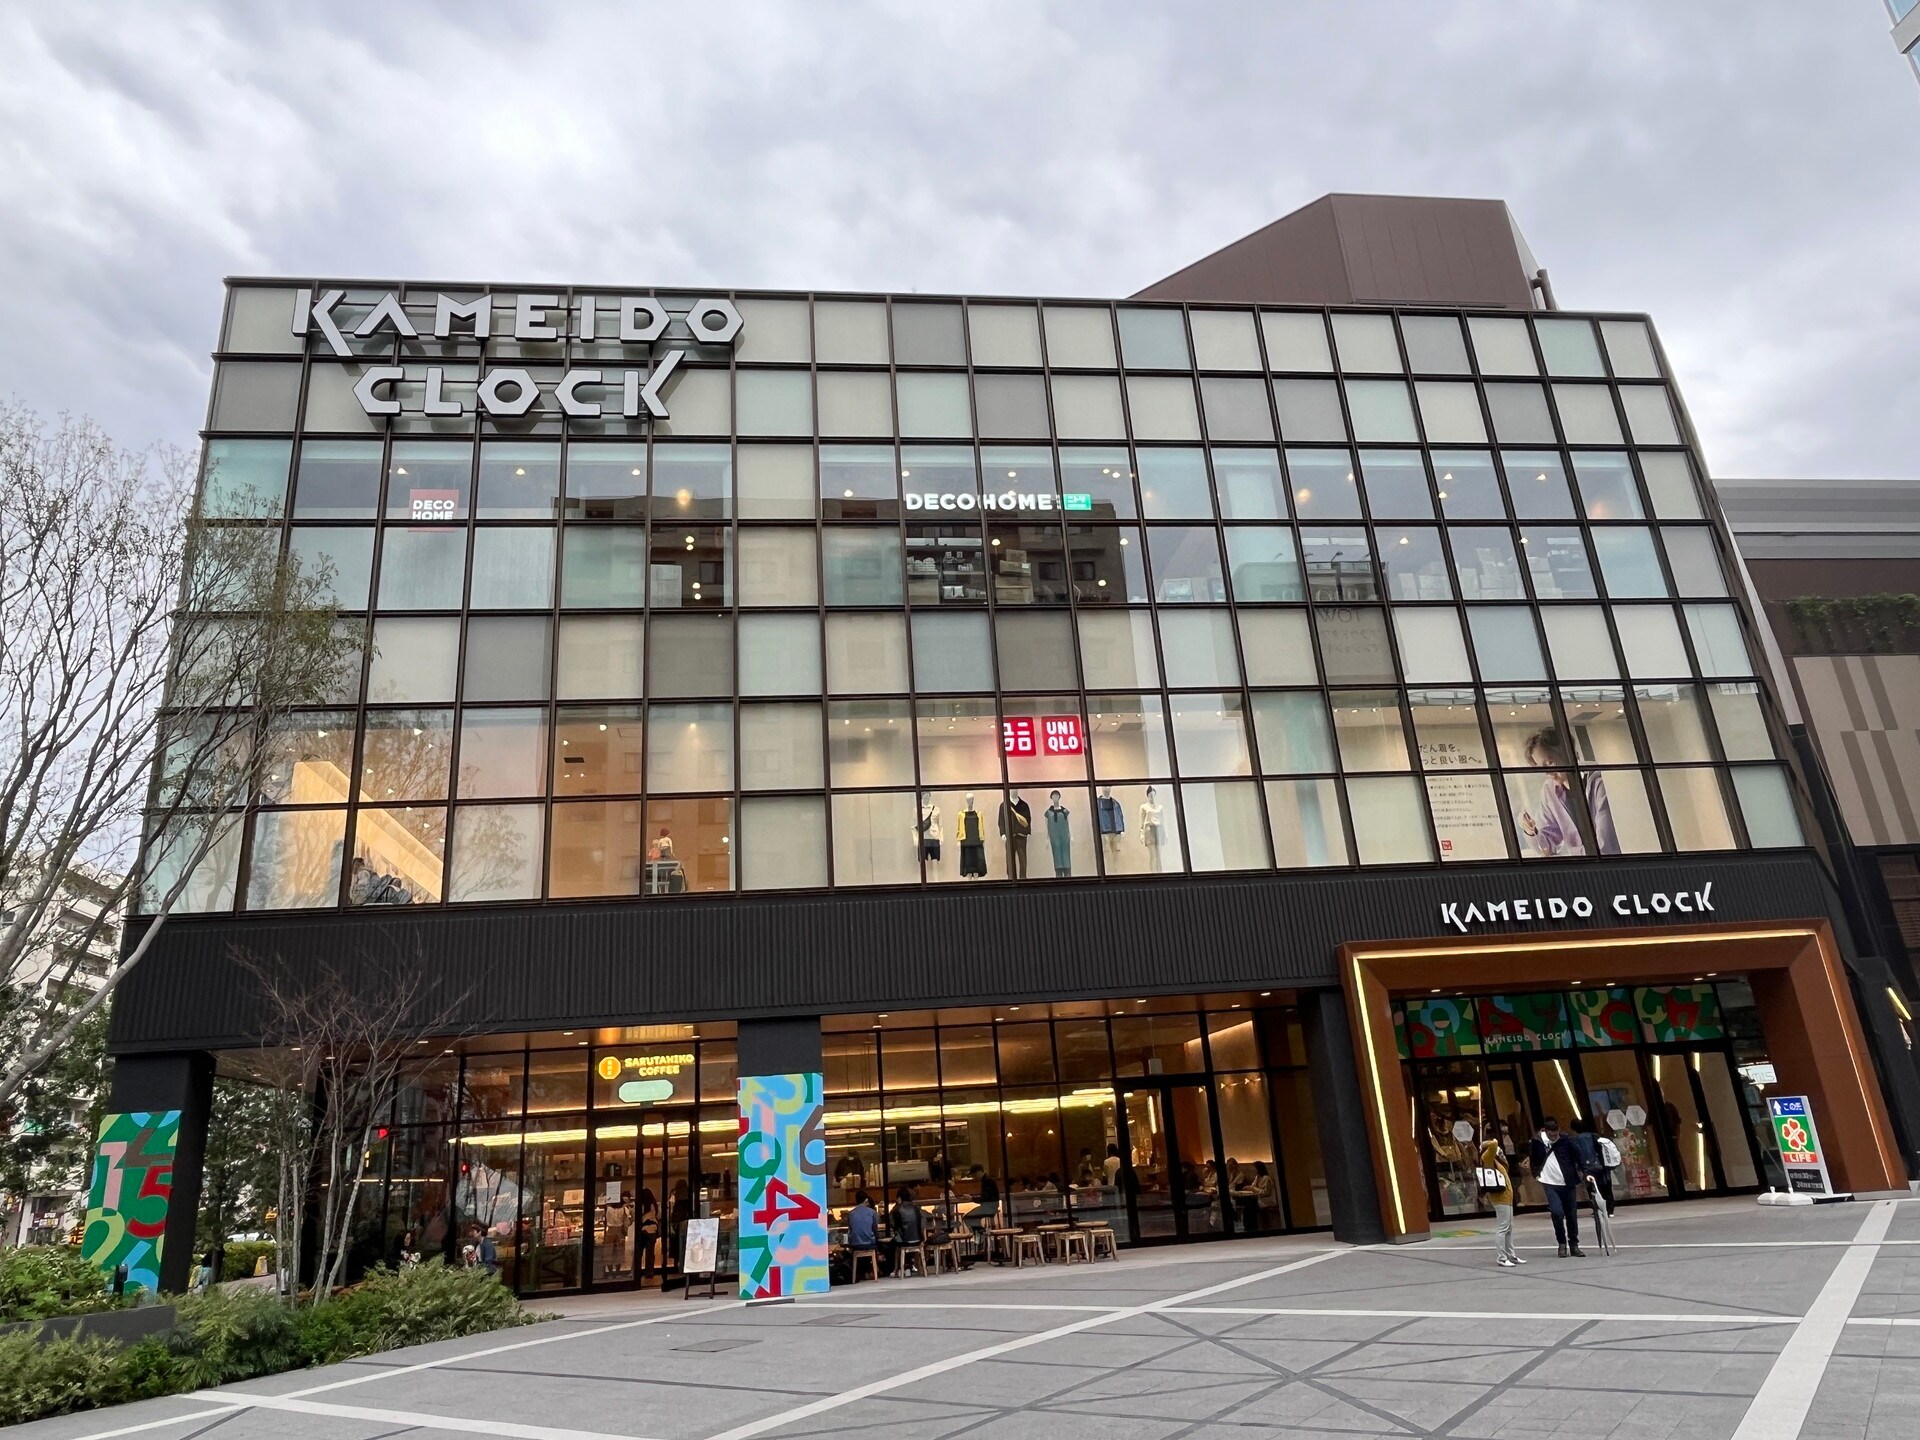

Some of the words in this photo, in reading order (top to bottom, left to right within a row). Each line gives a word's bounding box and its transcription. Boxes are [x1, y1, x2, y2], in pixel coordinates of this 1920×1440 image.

[291, 289, 744, 357] KAMEIDO
[353, 350, 685, 419] CLOCK
[413, 500, 455, 510] DECO
[905, 493, 975, 510] DECO
[977, 493, 1053, 510] HOME
[412, 511, 454, 520] HOME
[1046, 721, 1074, 735] UNI
[1048, 736, 1079, 752] QLO
[1441, 896, 1594, 933] KAMEIDO
[1612, 881, 1715, 915] CLOCK
[1535, 1029, 1568, 1040] CLOCK
[624, 1053, 695, 1068] SARUTAHIKO
[638, 1064, 680, 1077] COFFEE
[1789, 1153, 1812, 1163] LIFE
